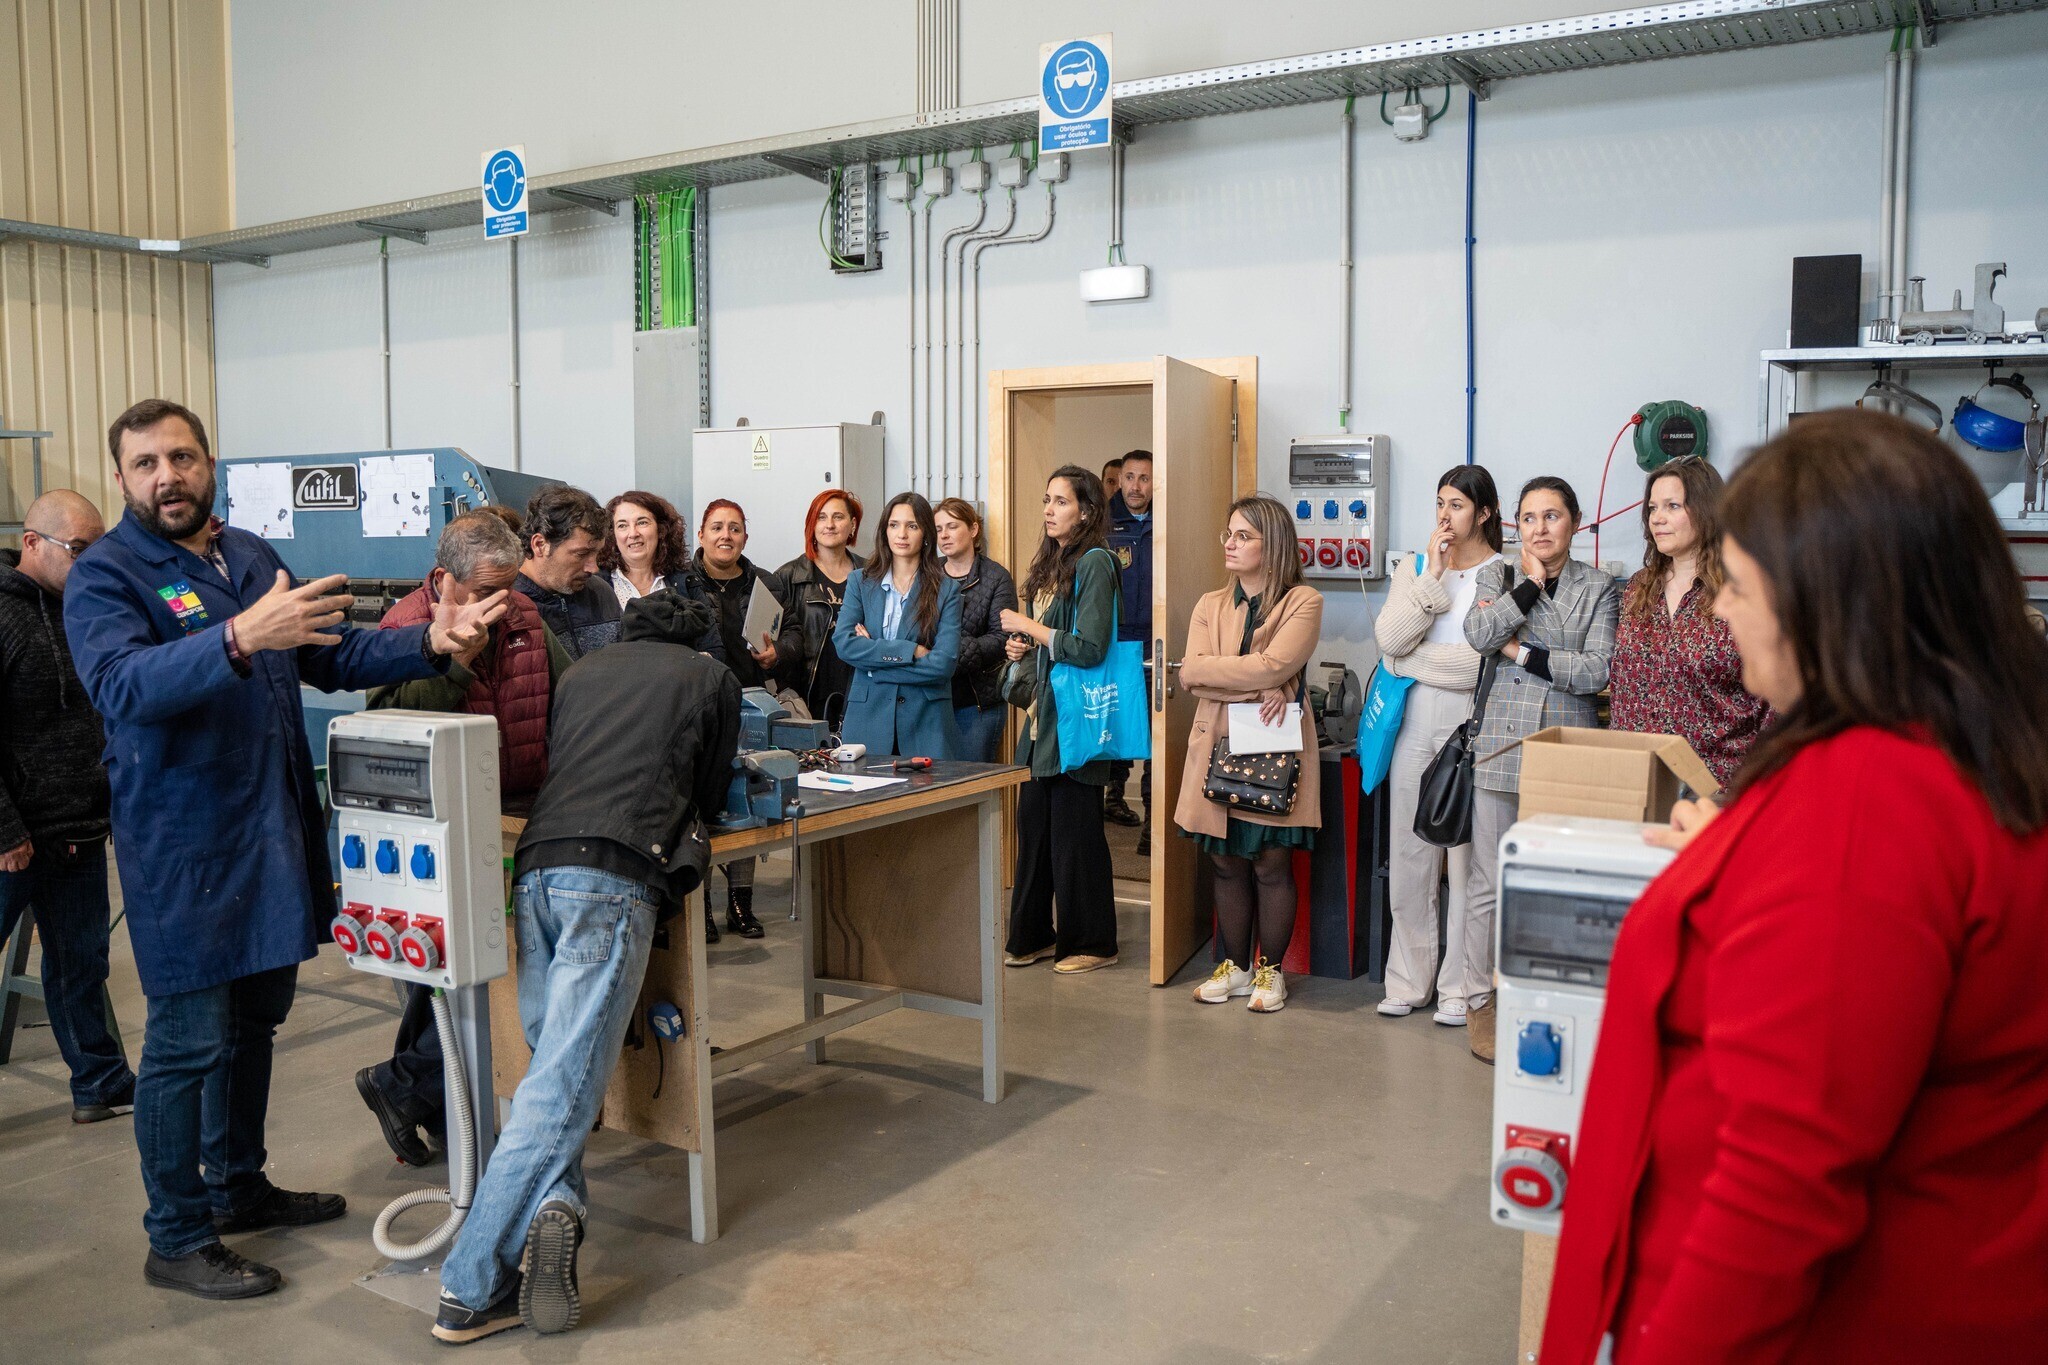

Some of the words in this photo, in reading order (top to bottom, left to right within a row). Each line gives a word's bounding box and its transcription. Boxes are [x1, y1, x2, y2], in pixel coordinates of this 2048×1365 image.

[1059, 123, 1091, 132] Obrigatório
[1068, 131, 1087, 139] óculos
[1060, 138, 1089, 147] protecção
